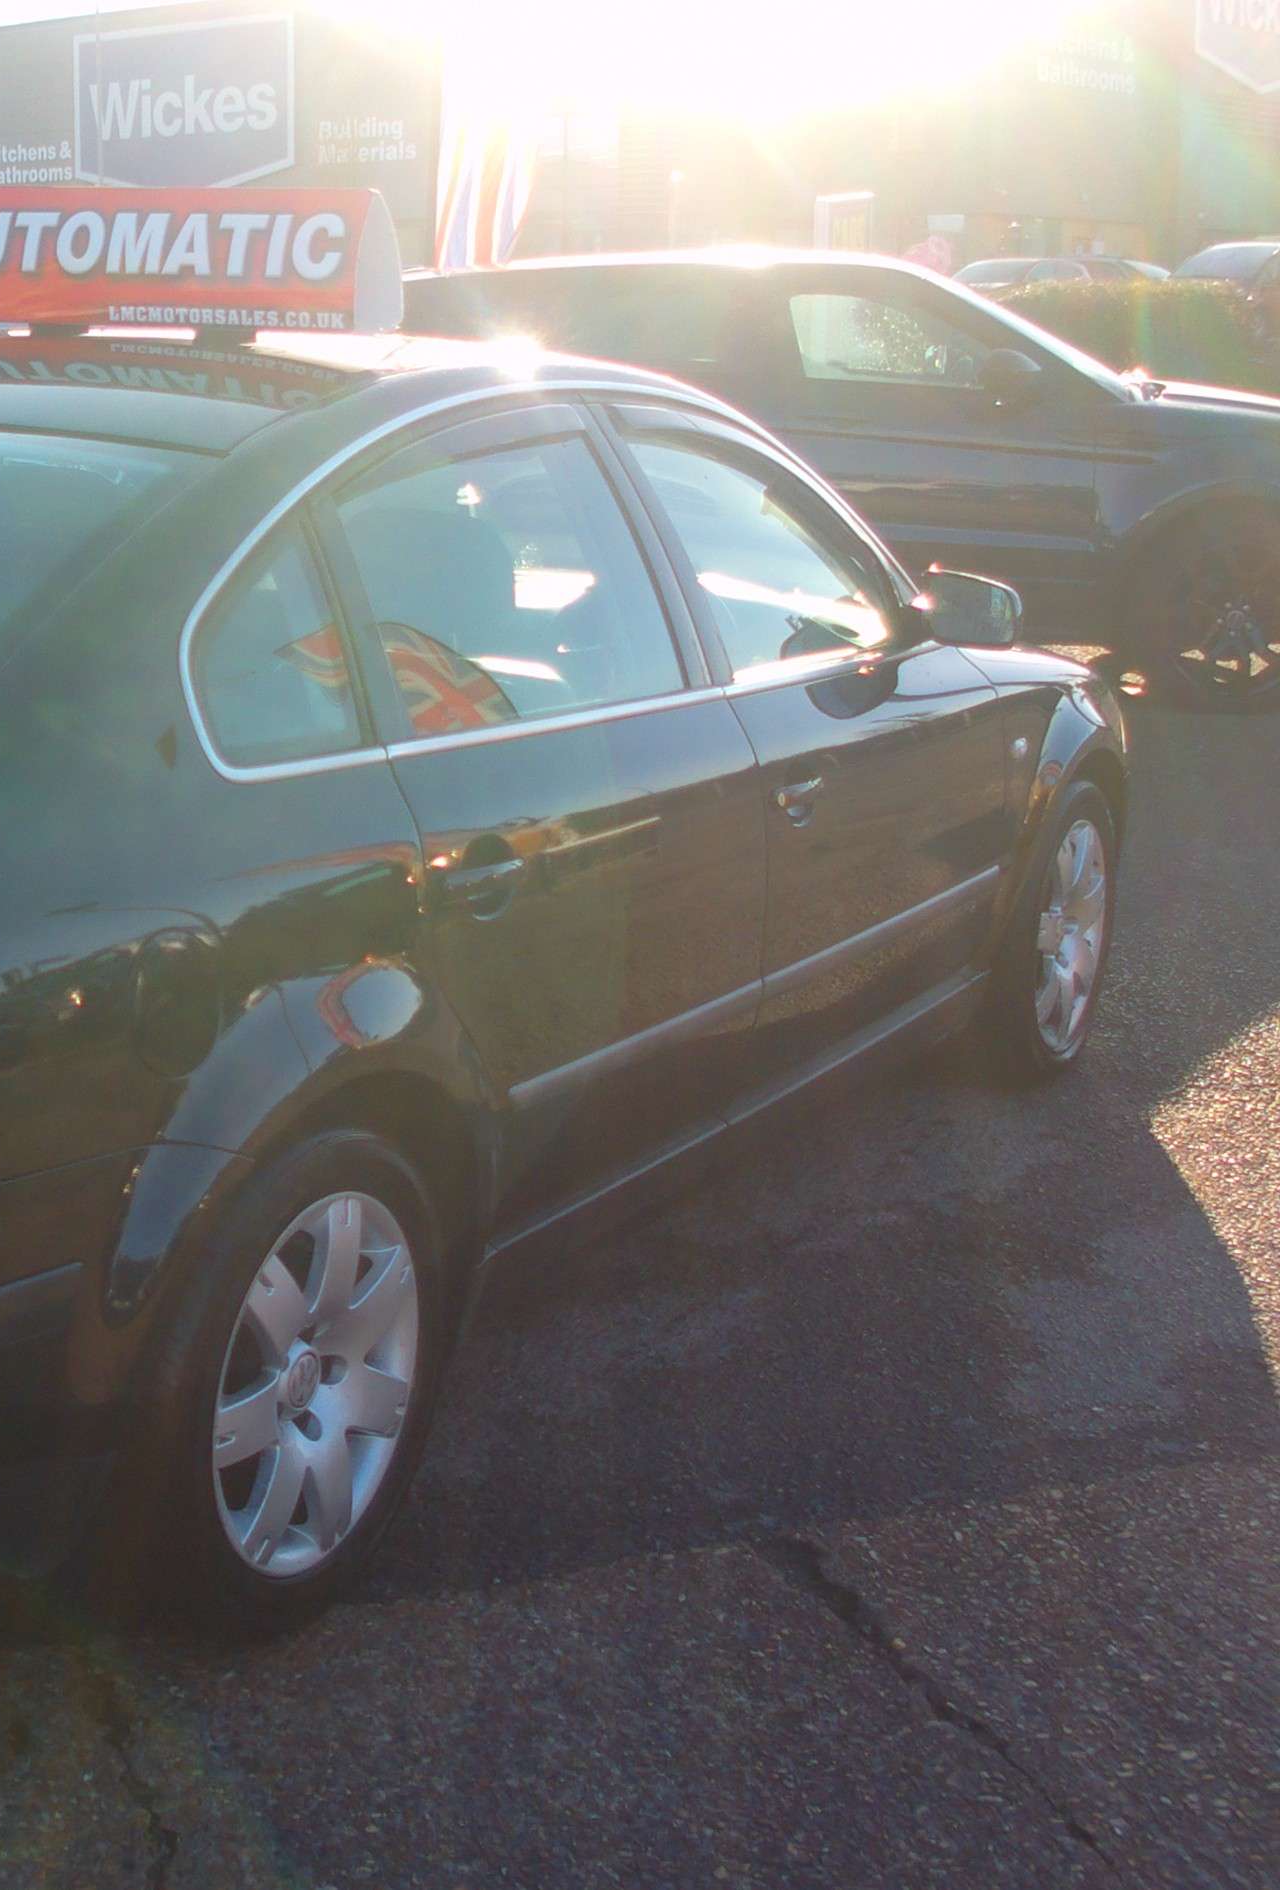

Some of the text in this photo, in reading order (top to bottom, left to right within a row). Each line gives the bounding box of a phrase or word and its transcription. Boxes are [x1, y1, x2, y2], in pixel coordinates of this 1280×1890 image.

[89, 74, 277, 141] Wickes
[60, 140, 73, 160] &
[108, 305, 345, 330] LMCMOTORSALES.CO.UK
